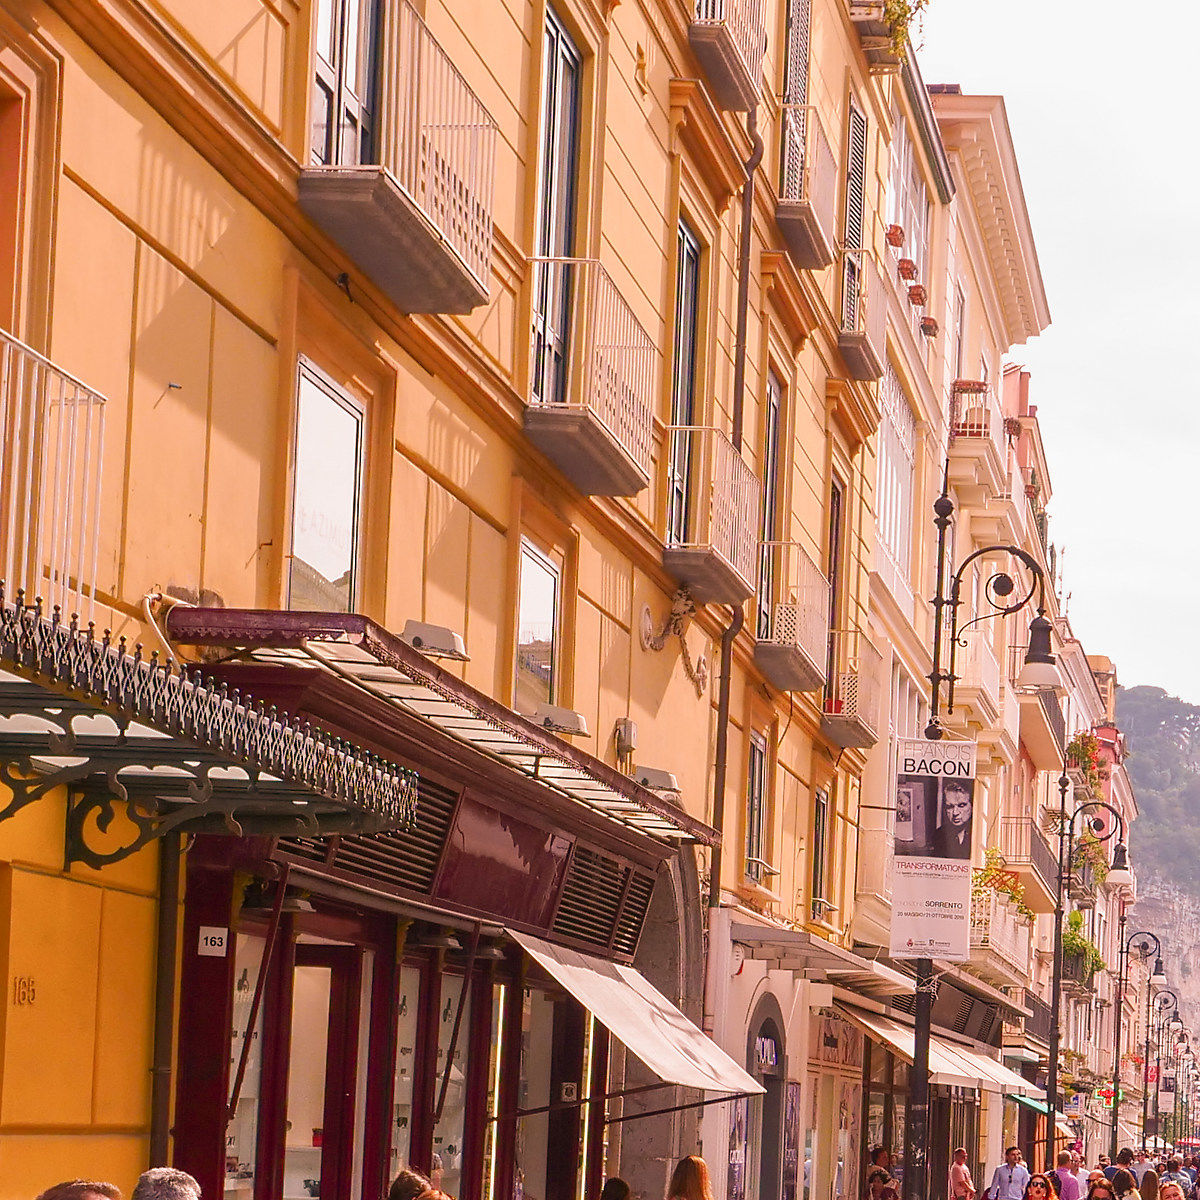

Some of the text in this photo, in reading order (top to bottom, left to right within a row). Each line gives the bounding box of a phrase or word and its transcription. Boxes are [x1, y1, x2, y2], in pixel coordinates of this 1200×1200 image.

[904, 741, 971, 760] FRANCIS
[904, 758, 970, 776] BACON
[897, 862, 969, 873] TRANSFORMATIONS
[925, 900, 963, 909] SORRENTO
[203, 936, 224, 947] 163
[14, 977, 36, 1006] 165
